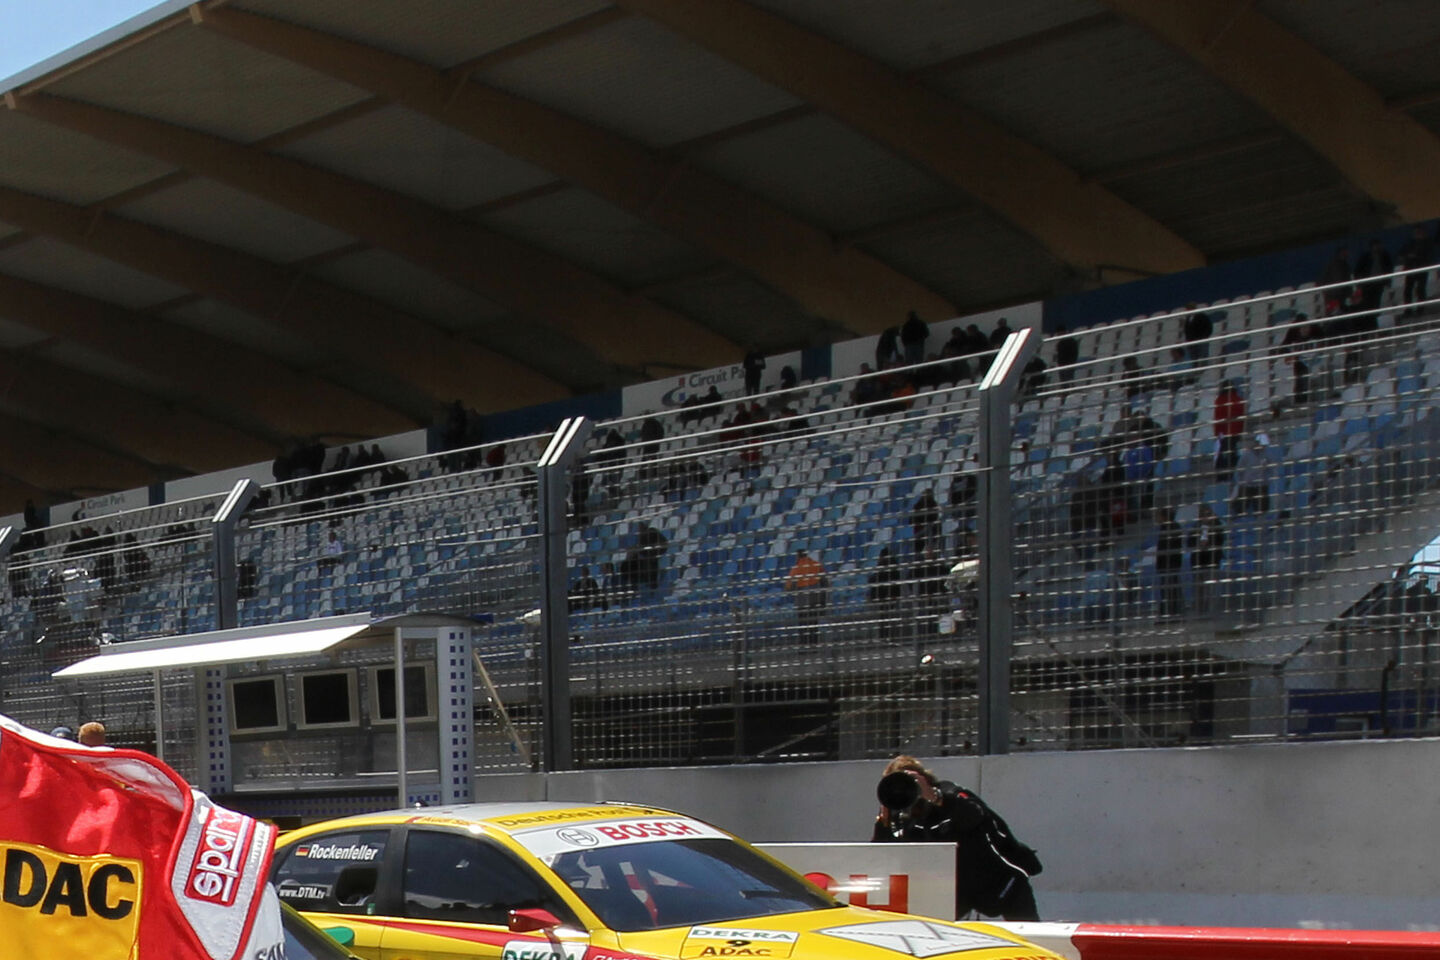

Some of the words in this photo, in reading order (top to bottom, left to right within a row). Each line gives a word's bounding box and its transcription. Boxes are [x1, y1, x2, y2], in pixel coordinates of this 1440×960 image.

[598, 821, 703, 841] BOSCH
[308, 844, 378, 860] Rockenfeller
[692, 929, 793, 941] DEKRA
[699, 946, 772, 957] ADAC
